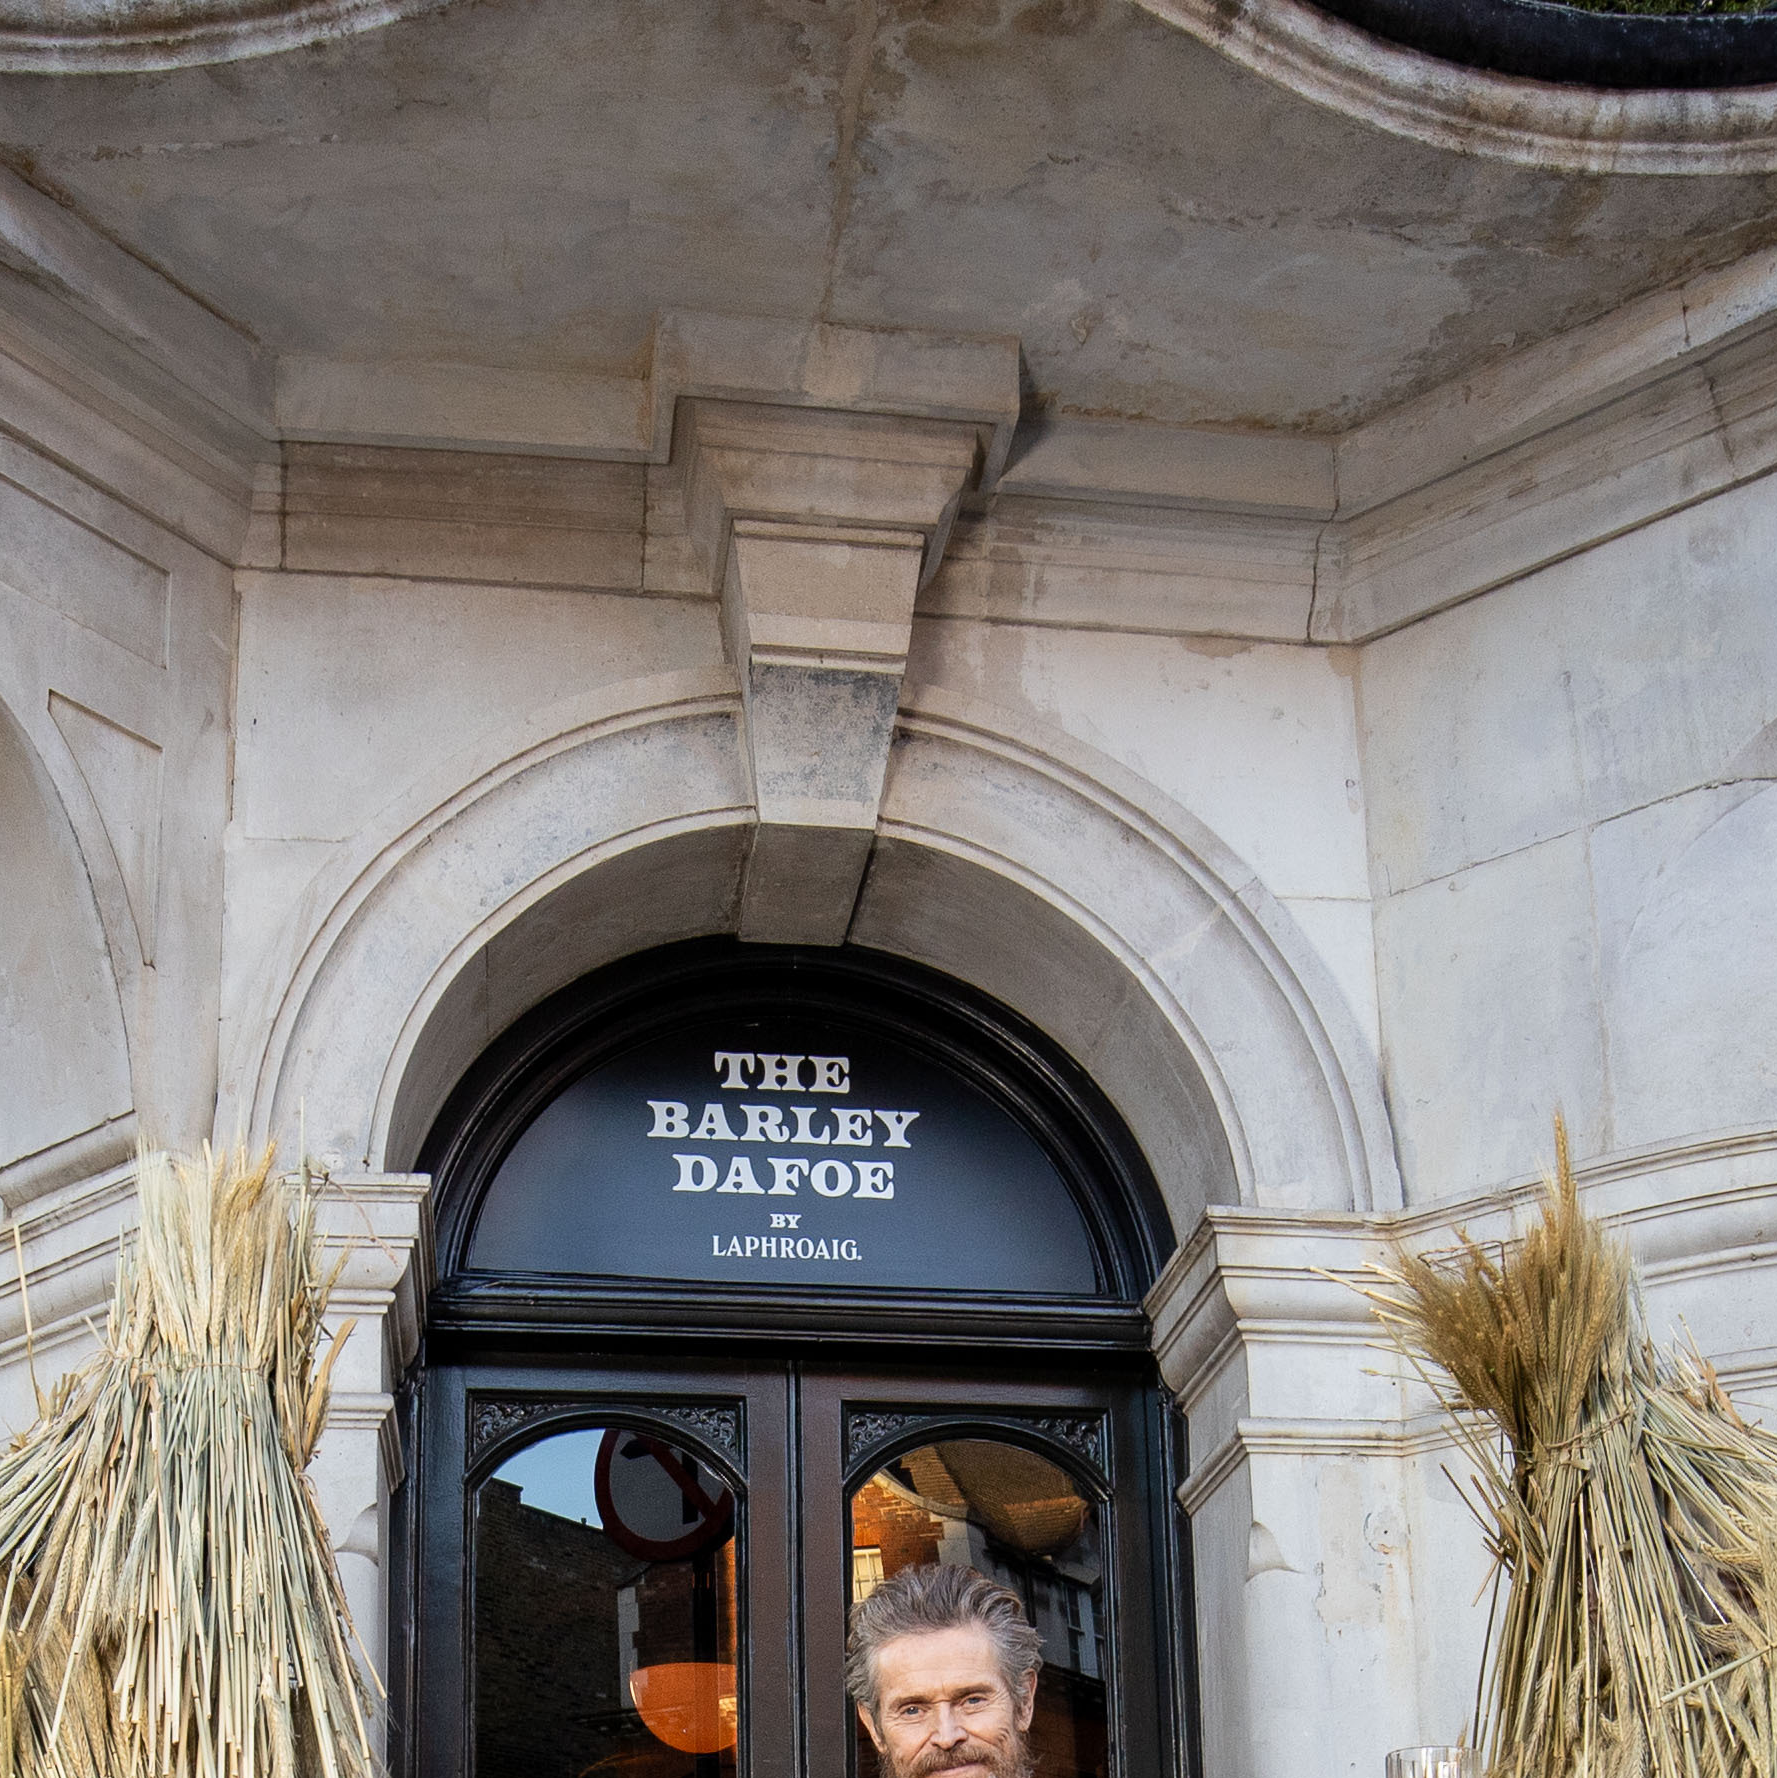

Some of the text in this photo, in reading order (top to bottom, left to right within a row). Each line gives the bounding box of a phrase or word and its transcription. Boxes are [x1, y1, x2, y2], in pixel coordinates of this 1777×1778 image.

[714, 1052, 851, 1094] THE
[646, 1100, 920, 1149] BARLEY
[672, 1153, 895, 1200] DAFOE
[769, 1213, 802, 1229] BY
